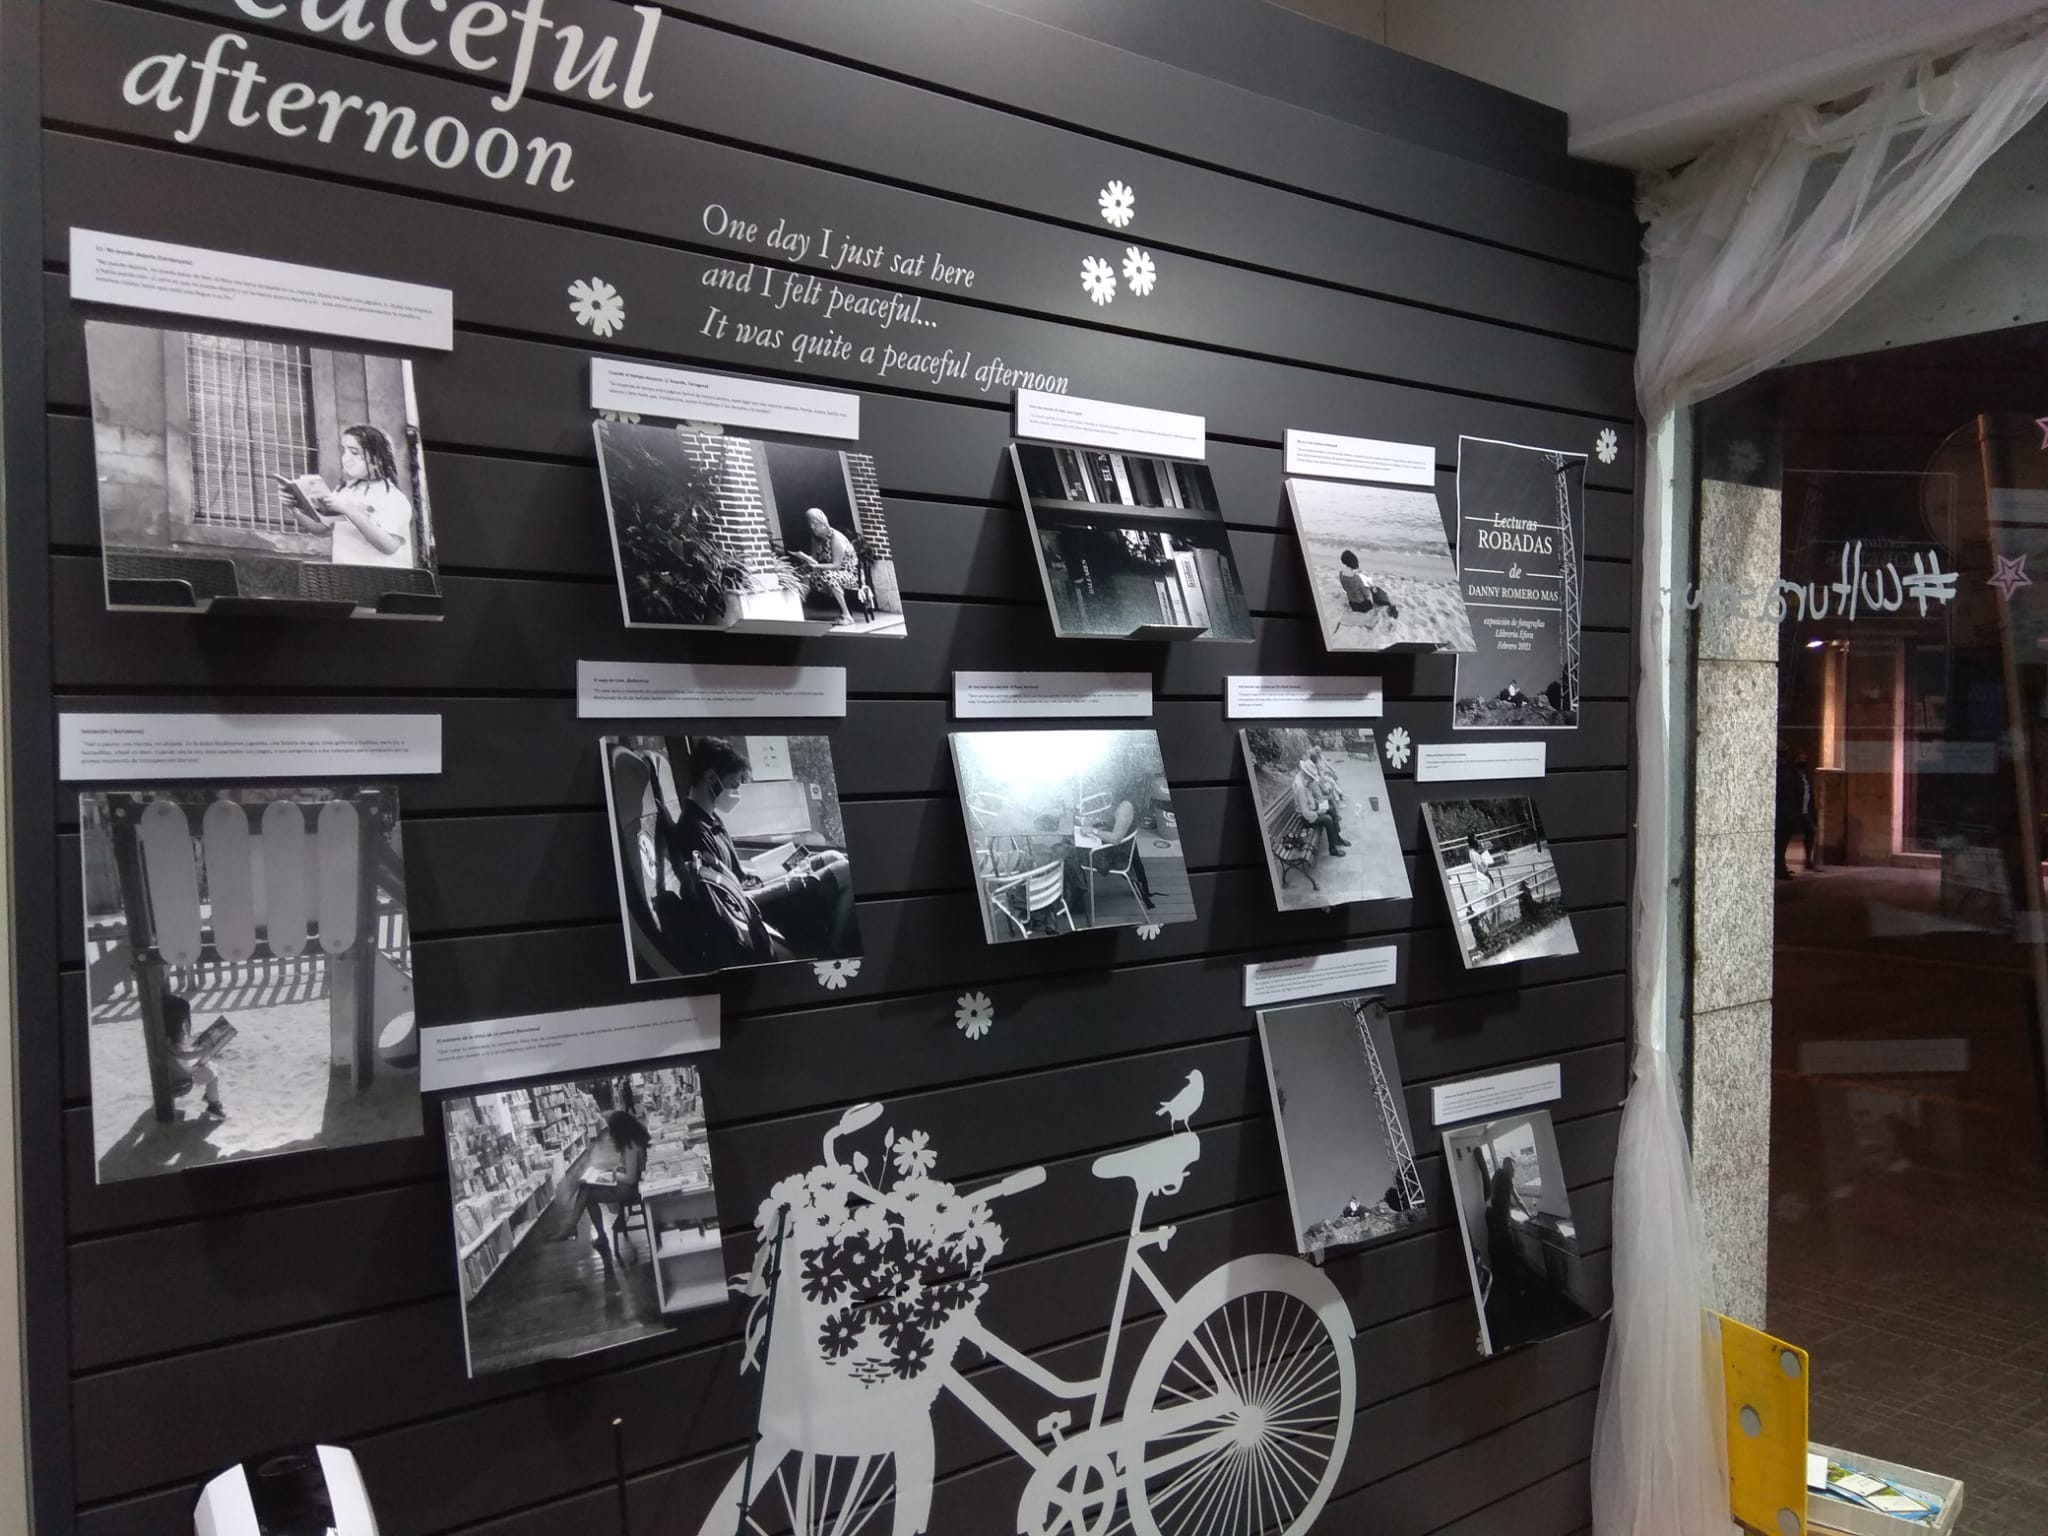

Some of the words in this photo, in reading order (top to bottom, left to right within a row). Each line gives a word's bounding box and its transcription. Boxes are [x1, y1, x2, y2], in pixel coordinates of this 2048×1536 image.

[233, 0, 663, 112] aceful
[121, 33, 576, 193] afternoon
[702, 203, 758, 243] One
[766, 218, 811, 262] day
[818, 227, 833, 259] I
[831, 235, 885, 271] just
[889, 253, 926, 277] sat
[930, 252, 976, 289] here
[701, 263, 755, 293] and
[760, 266, 776, 297] I
[775, 272, 823, 310] felt
[823, 284, 938, 329] peaceful...
[700, 304, 729, 340] It
[735, 319, 784, 350] was
[791, 328, 853, 364] quite
[859, 346, 876, 365] a
[877, 343, 972, 385] peaceful
[974, 357, 1070, 394] afternoon
[1477, 529, 1553, 555] ROBADAS
[1493, 512, 1538, 532] Lecturas
[1468, 584, 1501, 598] DANNY
[1501, 586, 1540, 601] ROMERO
[1540, 589, 1559, 602] MAS
[1508, 562, 1522, 579] de
